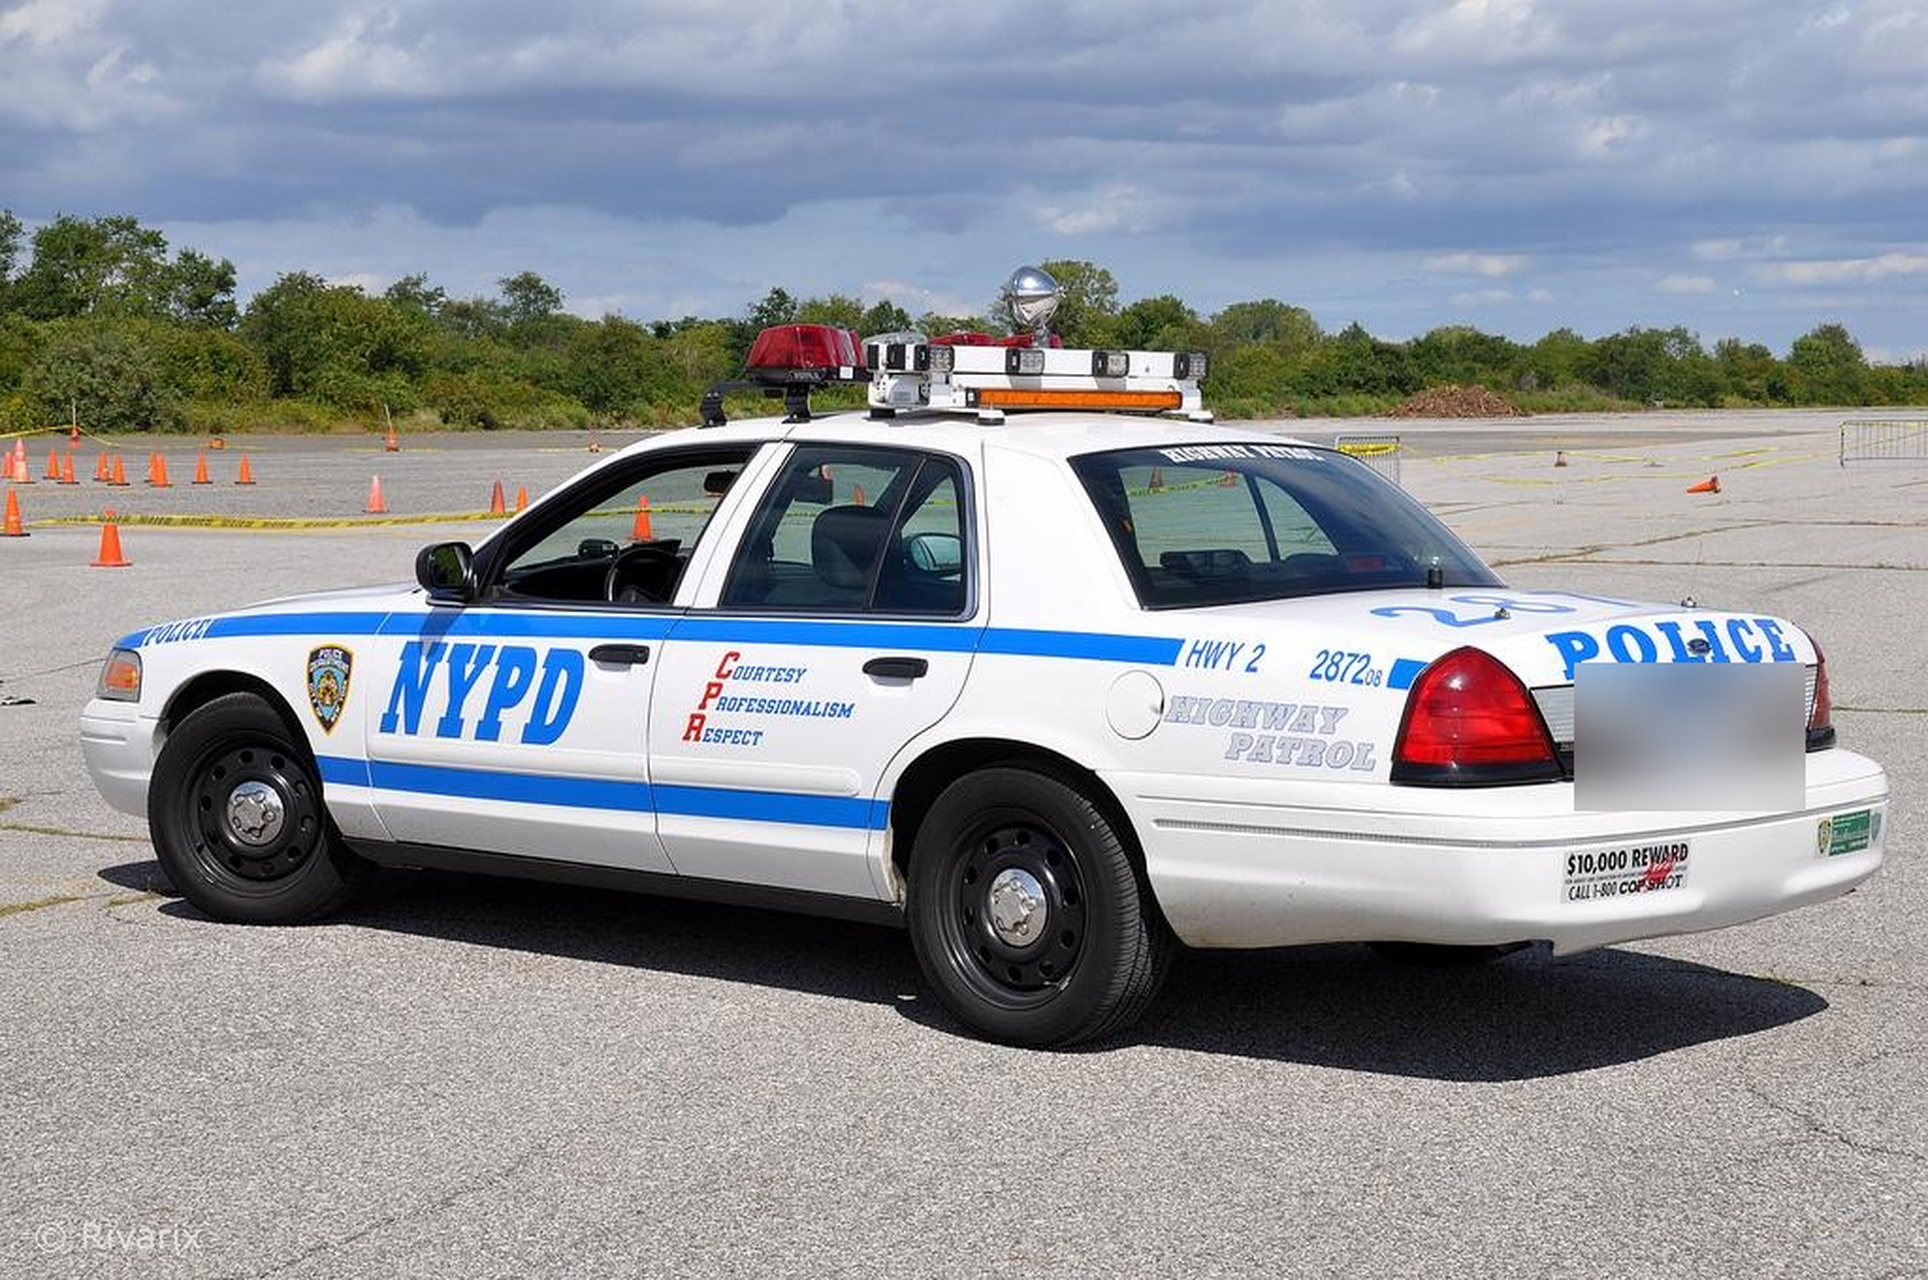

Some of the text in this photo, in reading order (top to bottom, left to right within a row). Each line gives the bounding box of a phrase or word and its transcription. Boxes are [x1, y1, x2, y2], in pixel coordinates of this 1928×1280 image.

[143, 618, 212, 647] POLICE
[1544, 618, 1797, 681] POLICE
[715, 651, 807, 684] COURTESY
[1184, 638, 1267, 673] HWY 2
[379, 641, 585, 746] NYPD
[698, 681, 856, 718] PROFESSIONALISM
[682, 713, 764, 746] RESPECT
[1163, 695, 1349, 735] HIGHWAY
[1224, 731, 1377, 772] PATROL
[1567, 850, 1628, 877] $10,000
[1631, 842, 1689, 868] REWARD
[1568, 882, 1591, 901] CALL
